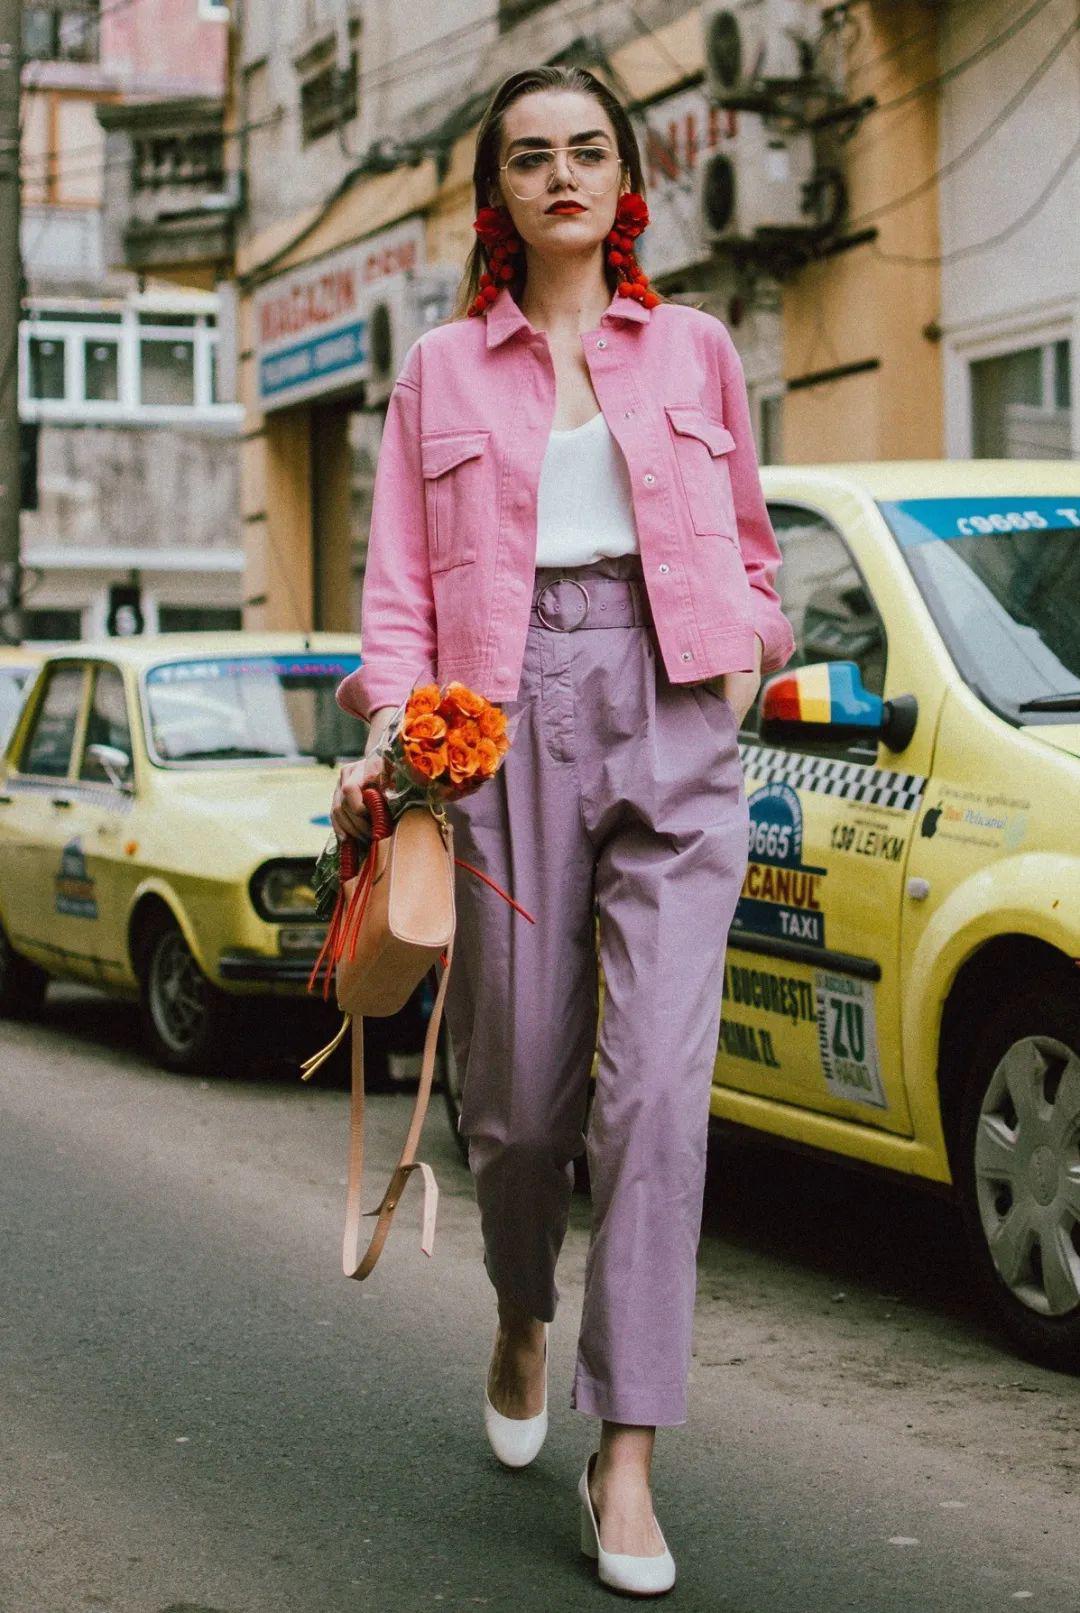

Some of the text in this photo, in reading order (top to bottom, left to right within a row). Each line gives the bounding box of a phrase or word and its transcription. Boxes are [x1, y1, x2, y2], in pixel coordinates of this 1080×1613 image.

[742, 864, 820, 911] CANUL
[779, 909, 819, 941] TAXI
[830, 997, 866, 1064] ZU
